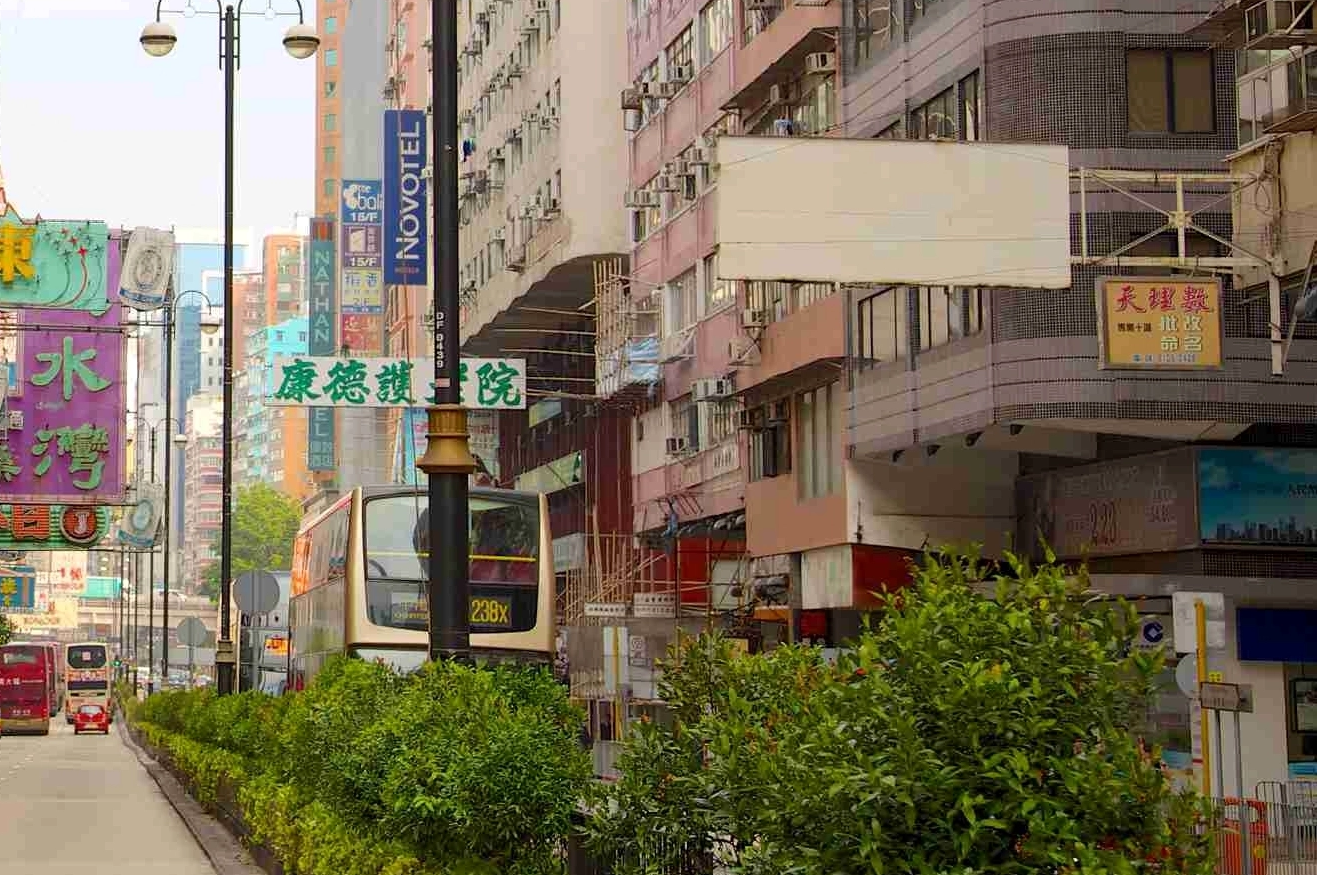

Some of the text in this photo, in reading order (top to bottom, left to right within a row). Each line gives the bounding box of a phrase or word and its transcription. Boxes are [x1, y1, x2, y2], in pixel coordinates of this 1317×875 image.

[395, 122, 421, 260] NOVOTEL
[314, 251, 330, 342] NATHAN
[436, 312, 444, 330] DF
